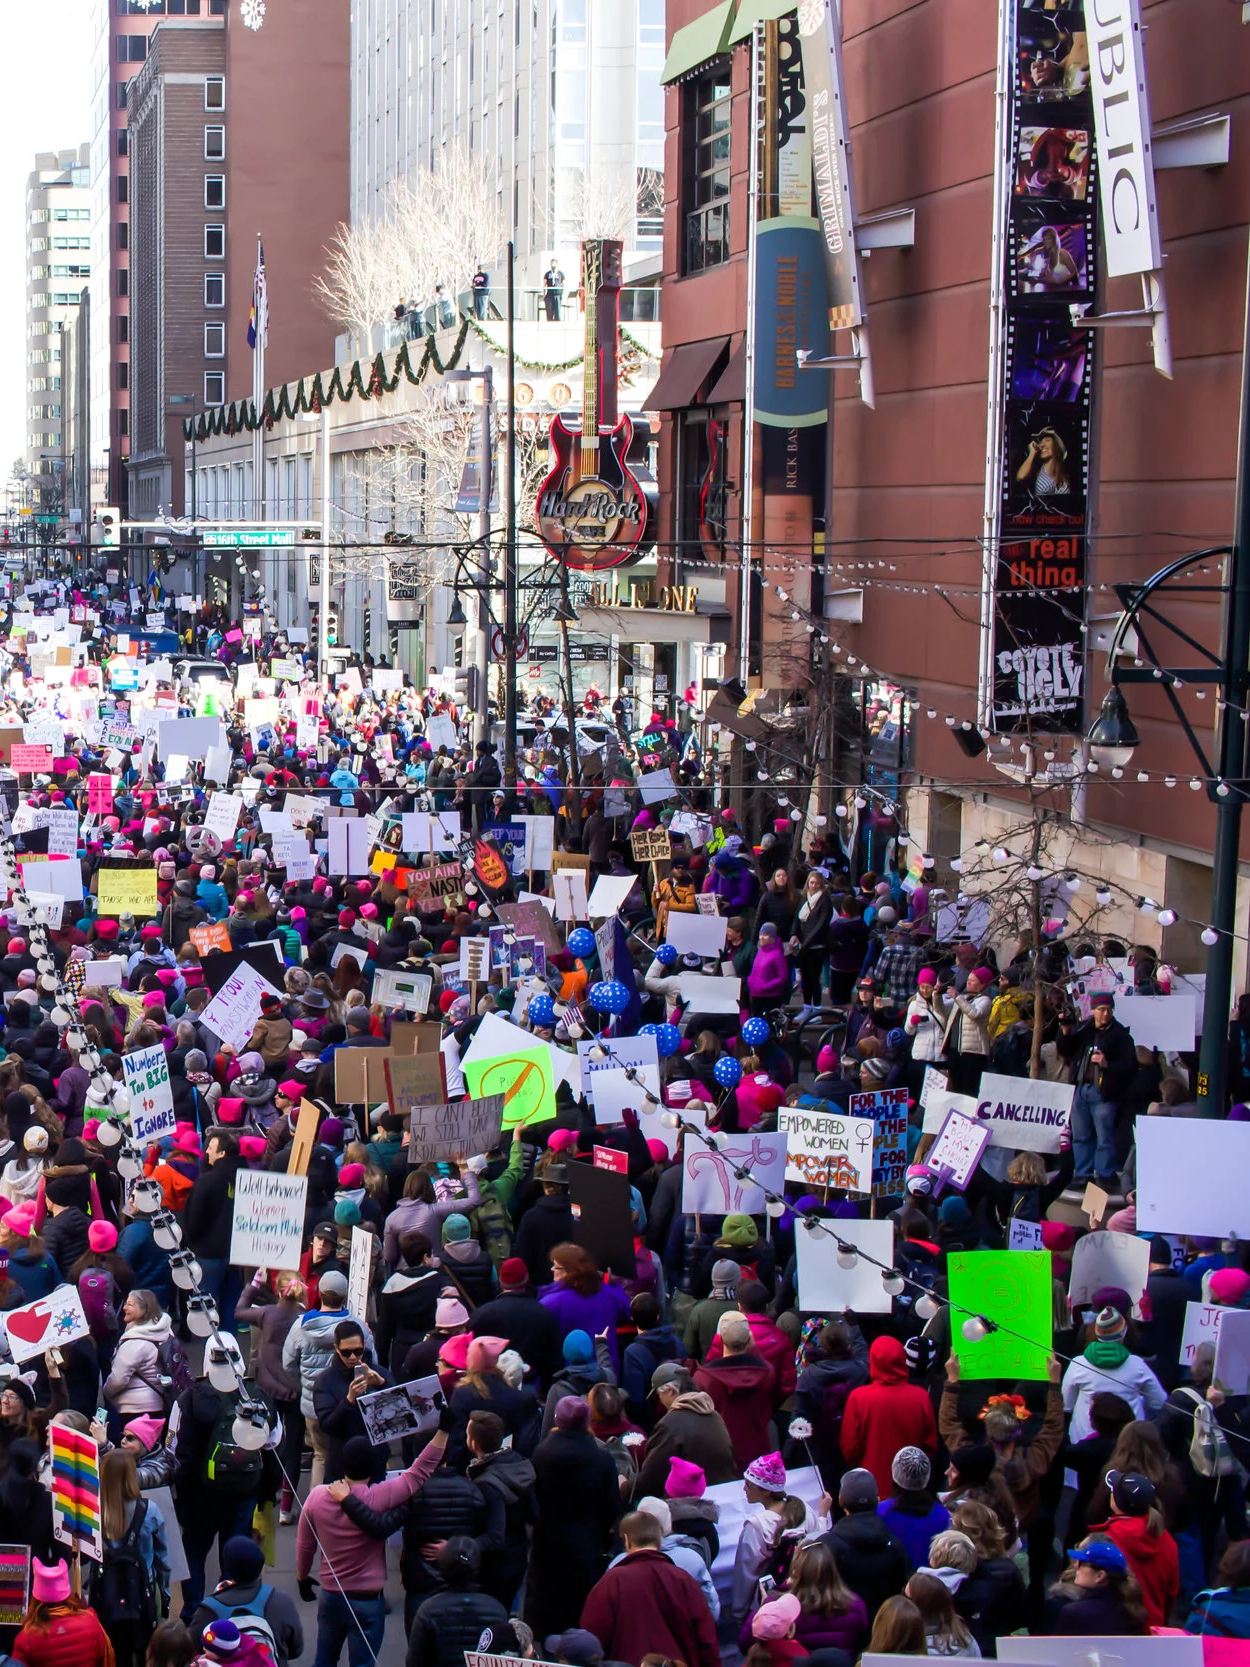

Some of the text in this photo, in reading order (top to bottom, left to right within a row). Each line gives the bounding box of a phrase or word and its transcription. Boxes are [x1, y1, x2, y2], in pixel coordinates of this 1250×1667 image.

[813, 88, 844, 254] GRIMALDI'S
[786, 458, 797, 488] RICK
[588, 491, 639, 525] Rock
[216, 532, 291, 545] 16th Street Mall
[1030, 536, 1078, 559] real
[1011, 562, 1084, 591] thing.
[996, 644, 1077, 674] COYOTE
[1018, 666, 1083, 699] UGLY
[632, 833, 647, 845] HER
[633, 846, 650, 860] HER
[406, 871, 431, 884] YOU
[124, 1049, 166, 1076] Numbers
[146, 1065, 169, 1091] BIG
[142, 1098, 155, 1112] to
[851, 1088, 908, 1109] FOR THE
[134, 1108, 175, 1141] IGNORE
[779, 1114, 846, 1135] EMPOWERED
[977, 1101, 1066, 1127] CANCELLING
[435, 1123, 460, 1140] STILL
[878, 1118, 907, 1134] THE
[804, 1135, 849, 1151] WOMEN
[786, 1153, 855, 1172] MPOWER
[880, 1151, 907, 1167] FOR
[238, 1174, 262, 1195] Well
[803, 1169, 860, 1189] WOMEN
[252, 1199, 287, 1218] Women
